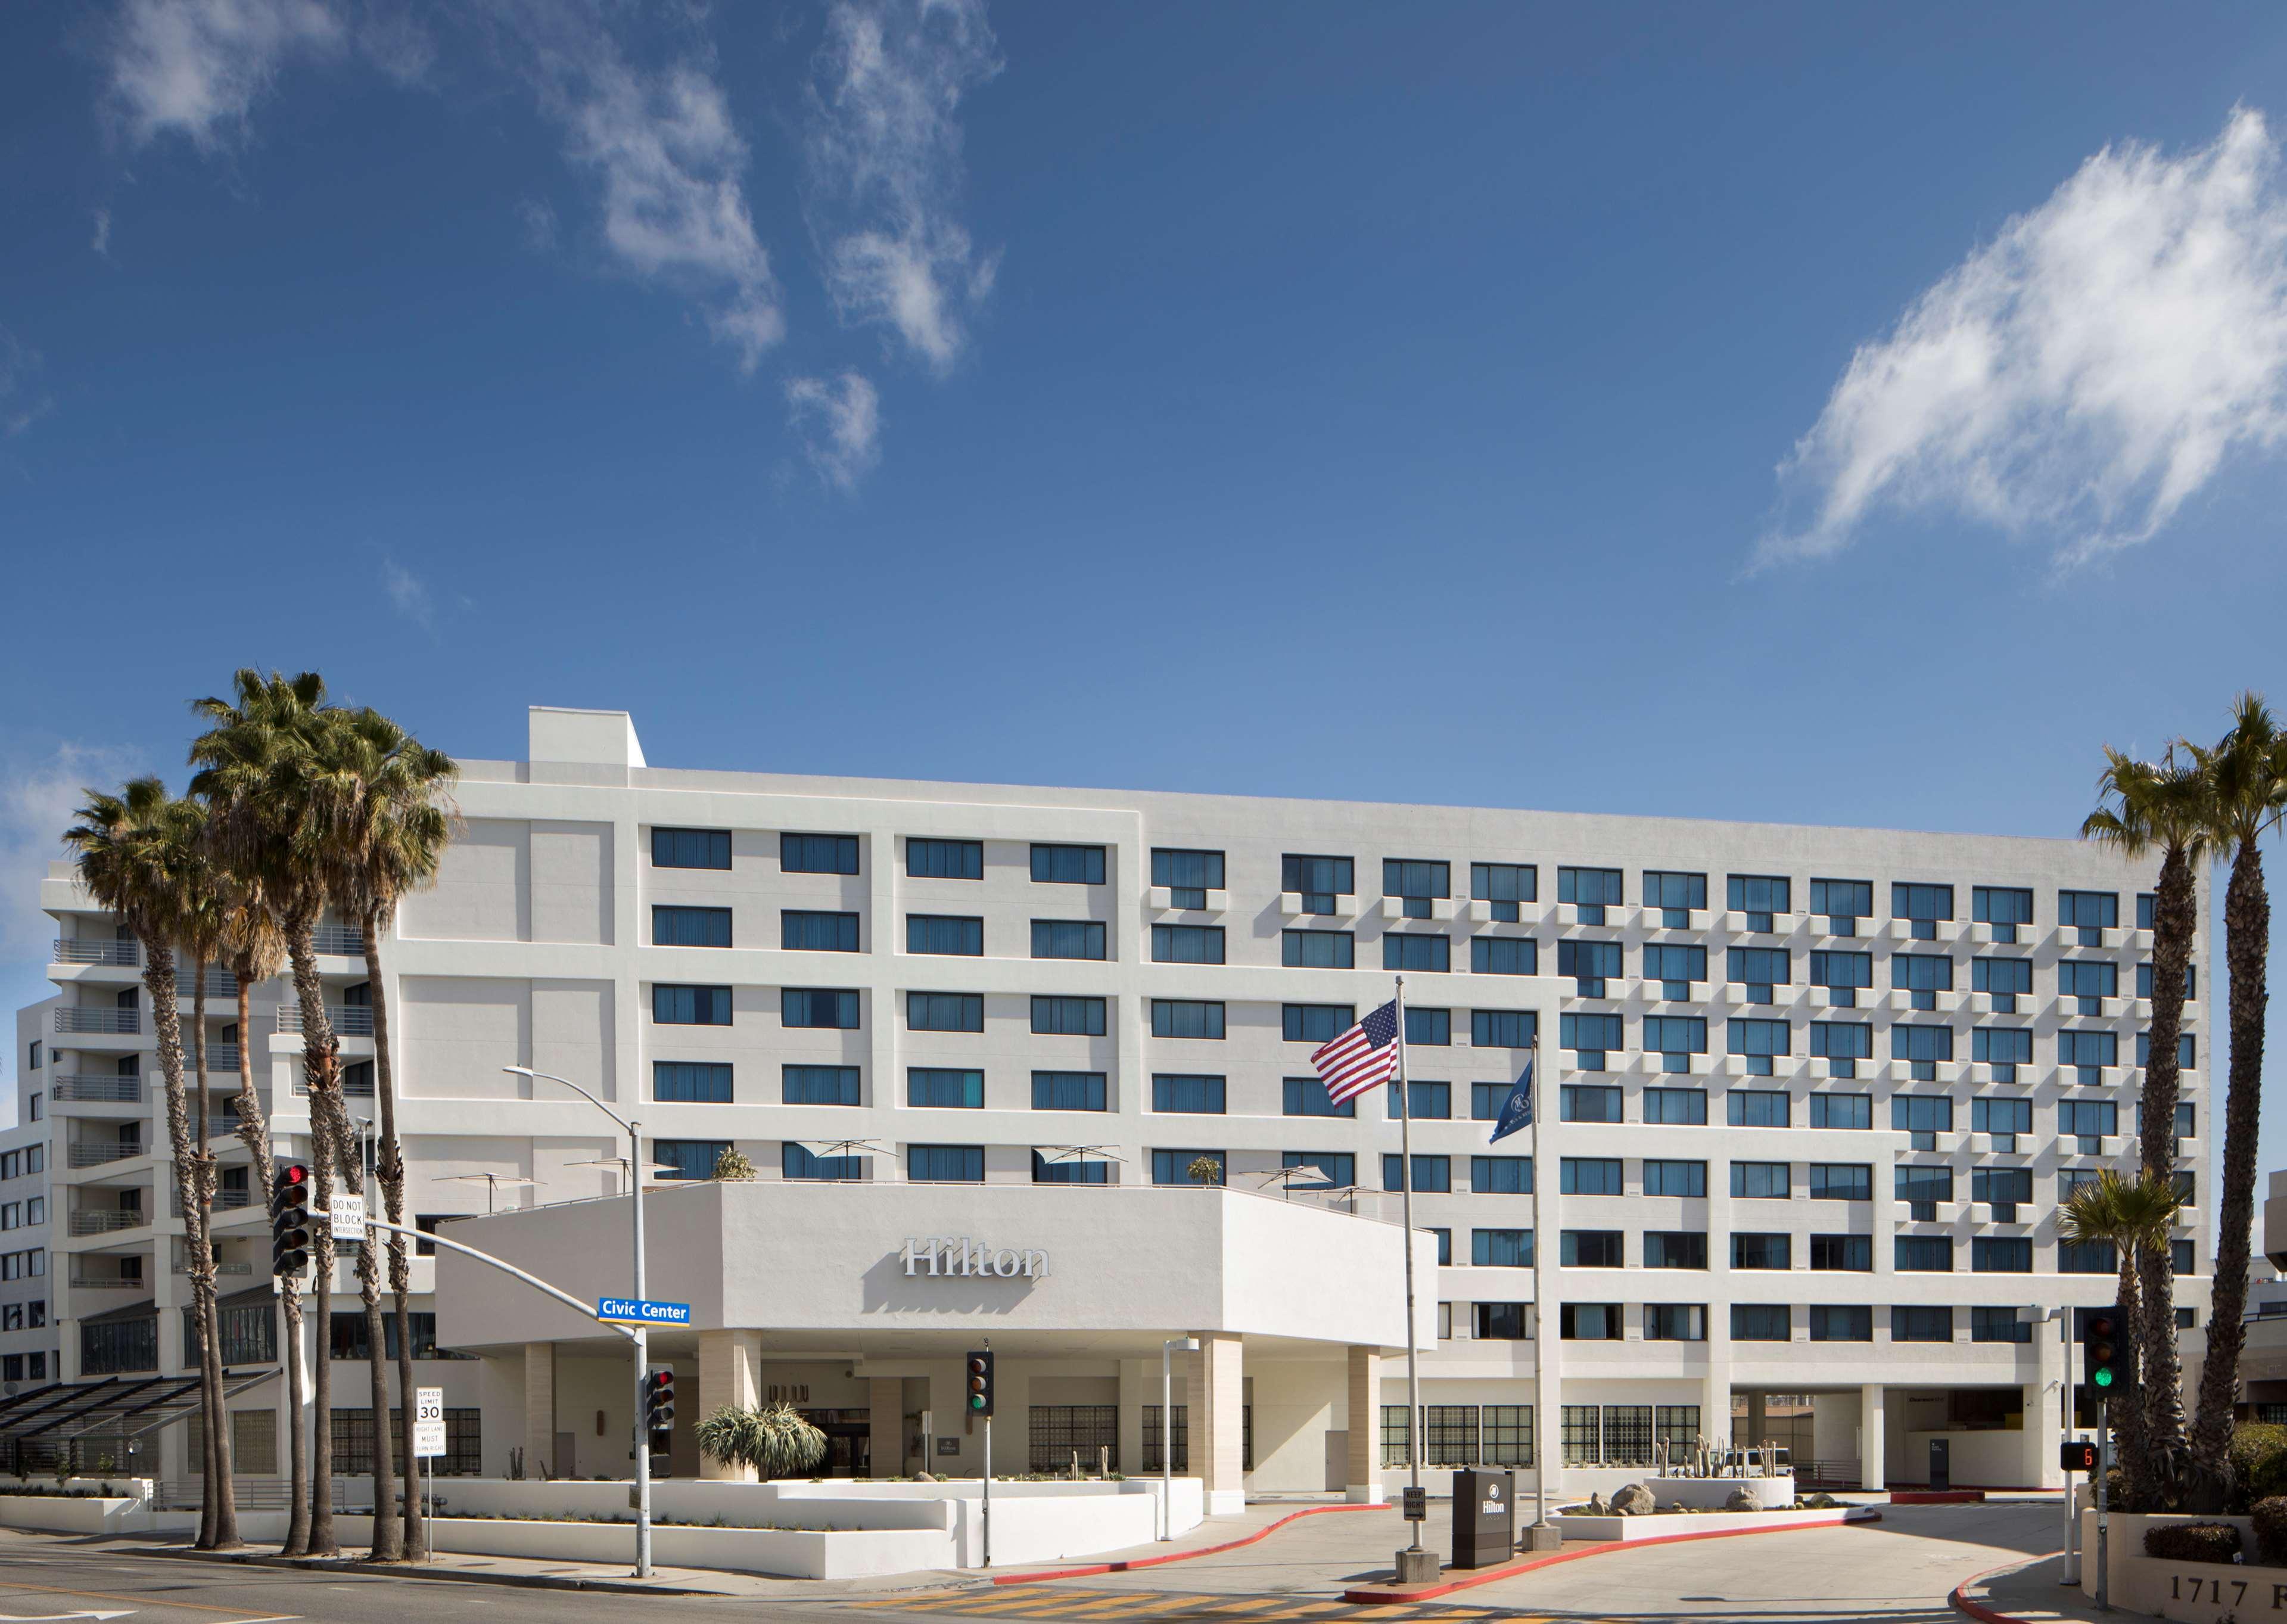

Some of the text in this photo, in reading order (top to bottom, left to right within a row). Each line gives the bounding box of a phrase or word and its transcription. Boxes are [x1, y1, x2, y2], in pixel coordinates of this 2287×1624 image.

[333, 1200, 361, 1211] DO NOT
[334, 1214, 362, 1225] BLOCK
[334, 1227, 363, 1235] INTERSECTION
[904, 1237, 1051, 1277] Hilton
[602, 1300, 686, 1319] Civic Center
[421, 1407, 439, 1418] 30
[2085, 1448, 2093, 1466] 6
[1483, 1500, 1504, 1514] Hilton
[2171, 1575, 2248, 1607] 1717
